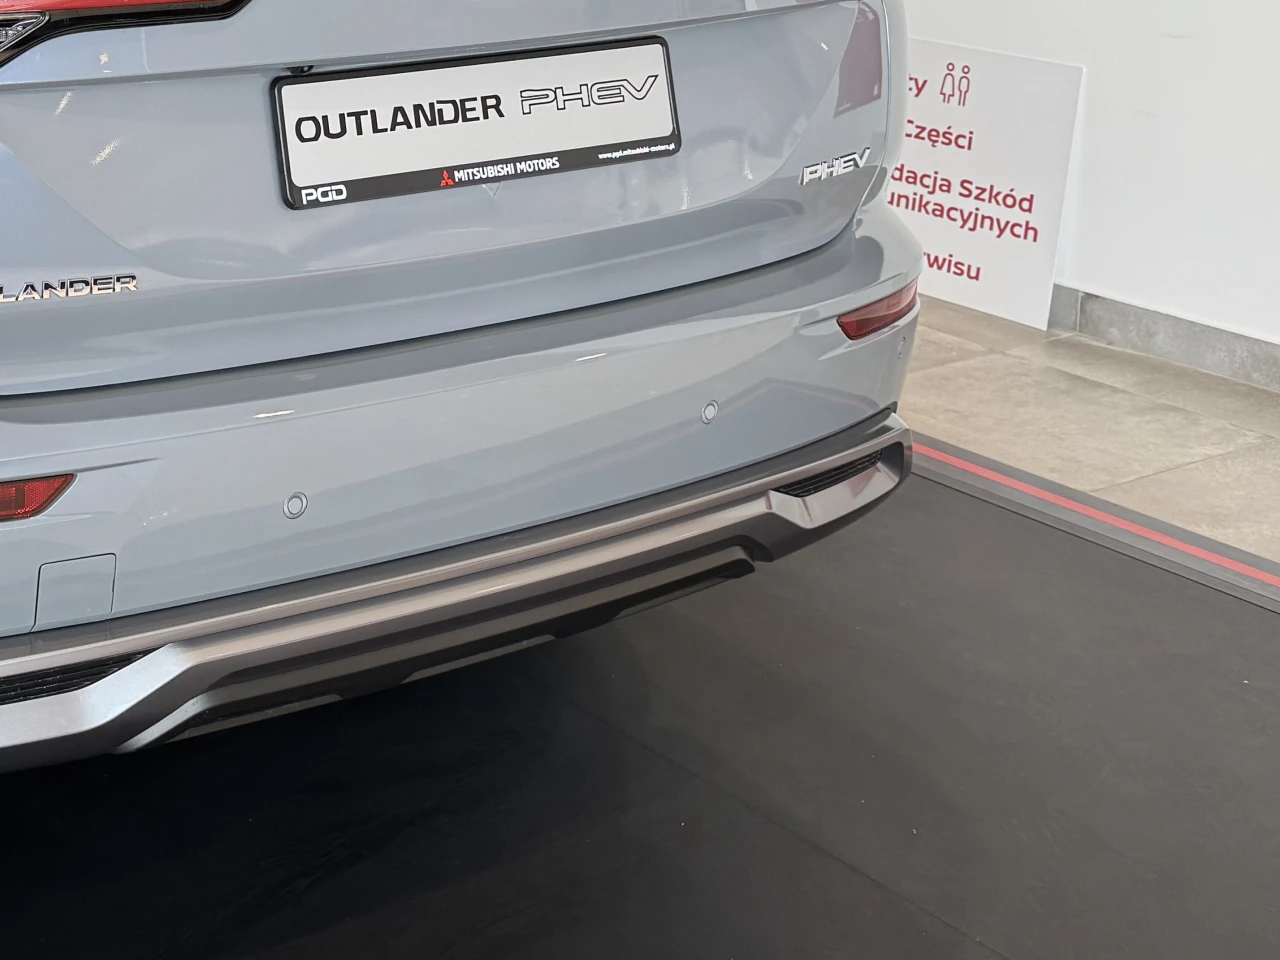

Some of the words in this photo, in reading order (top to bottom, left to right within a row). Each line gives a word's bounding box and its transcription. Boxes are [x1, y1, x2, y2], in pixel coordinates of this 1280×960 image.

[294, 93, 505, 144] OUTLANDER
[519, 73, 659, 116] PHEV
[453, 161, 516, 183] MITSUBISHI
[516, 156, 560, 177] MOTORS
[798, 146, 871, 186] PHEV
[301, 183, 347, 206] PGD
[958, 178, 1035, 215] Szkód
